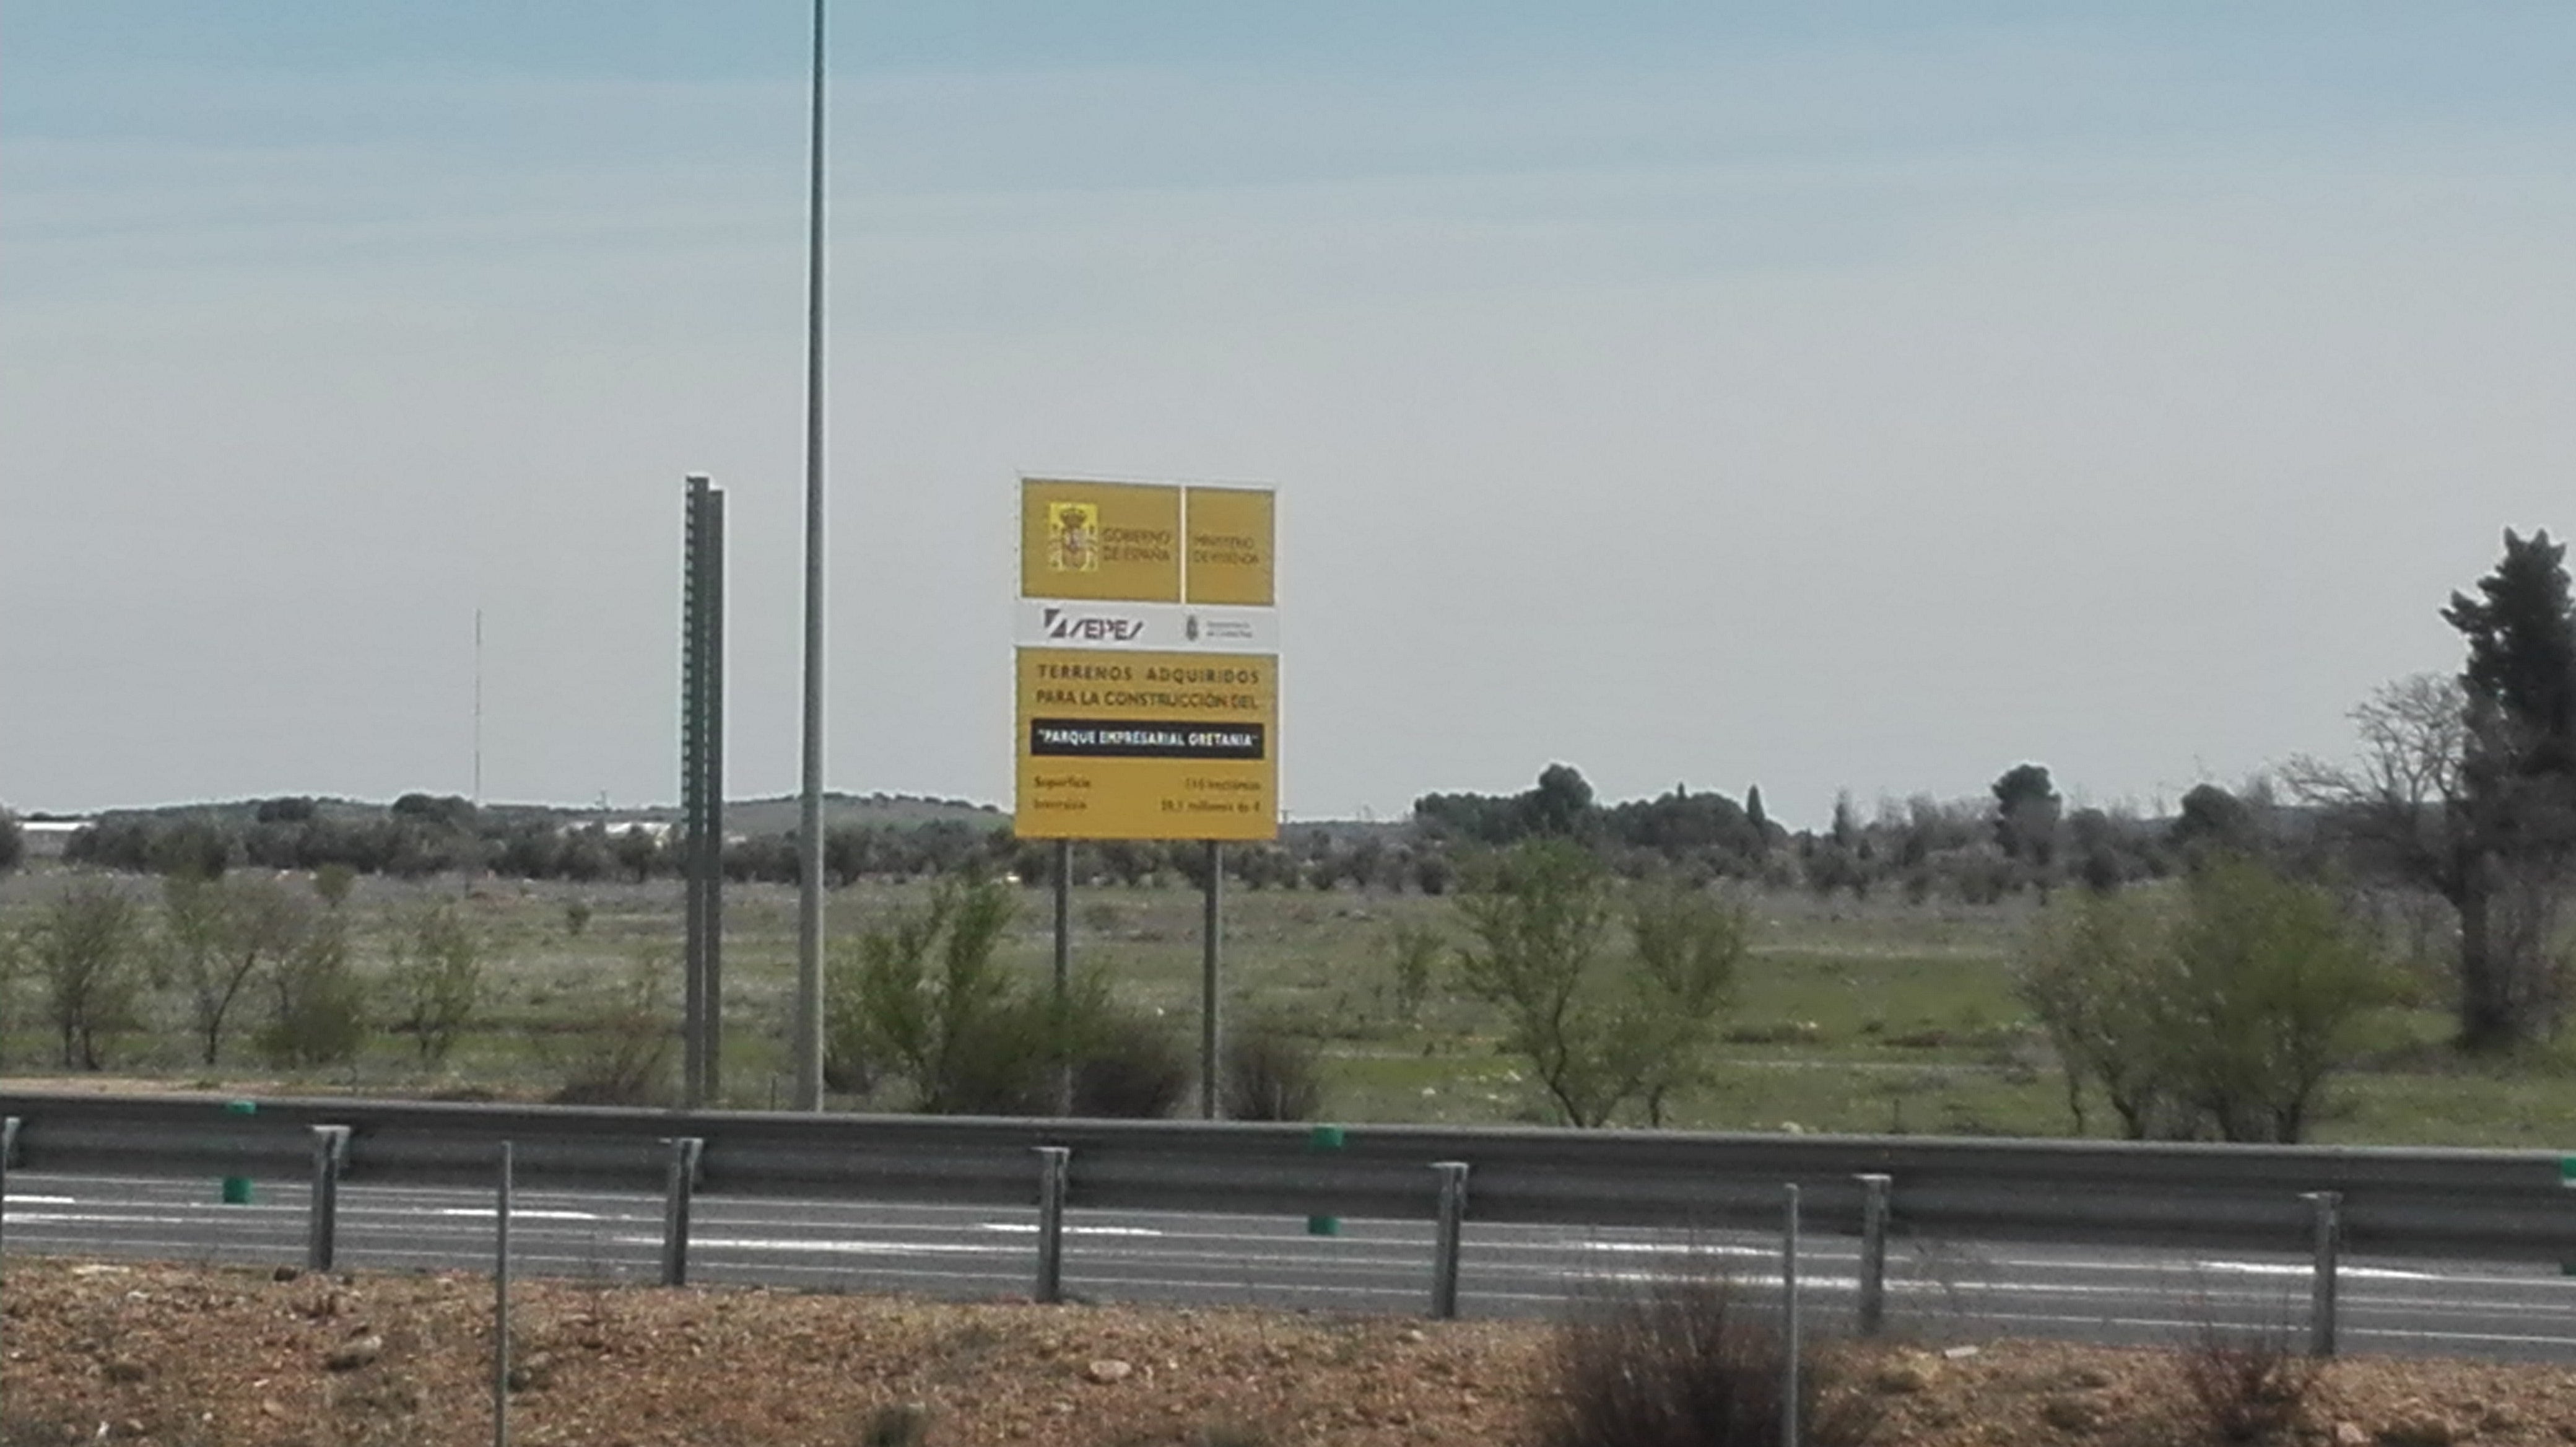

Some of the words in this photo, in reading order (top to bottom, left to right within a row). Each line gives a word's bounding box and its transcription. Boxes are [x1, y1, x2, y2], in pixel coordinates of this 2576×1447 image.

[1037, 664, 1132, 681] TERRENOS
[1146, 667, 1260, 684] ADQUIRIDOS
[1036, 689, 1076, 705] PARA
[1081, 691, 1100, 706] LA
[1230, 693, 1259, 710] DEL
[1099, 730, 1185, 747] EMPRESARIAL
